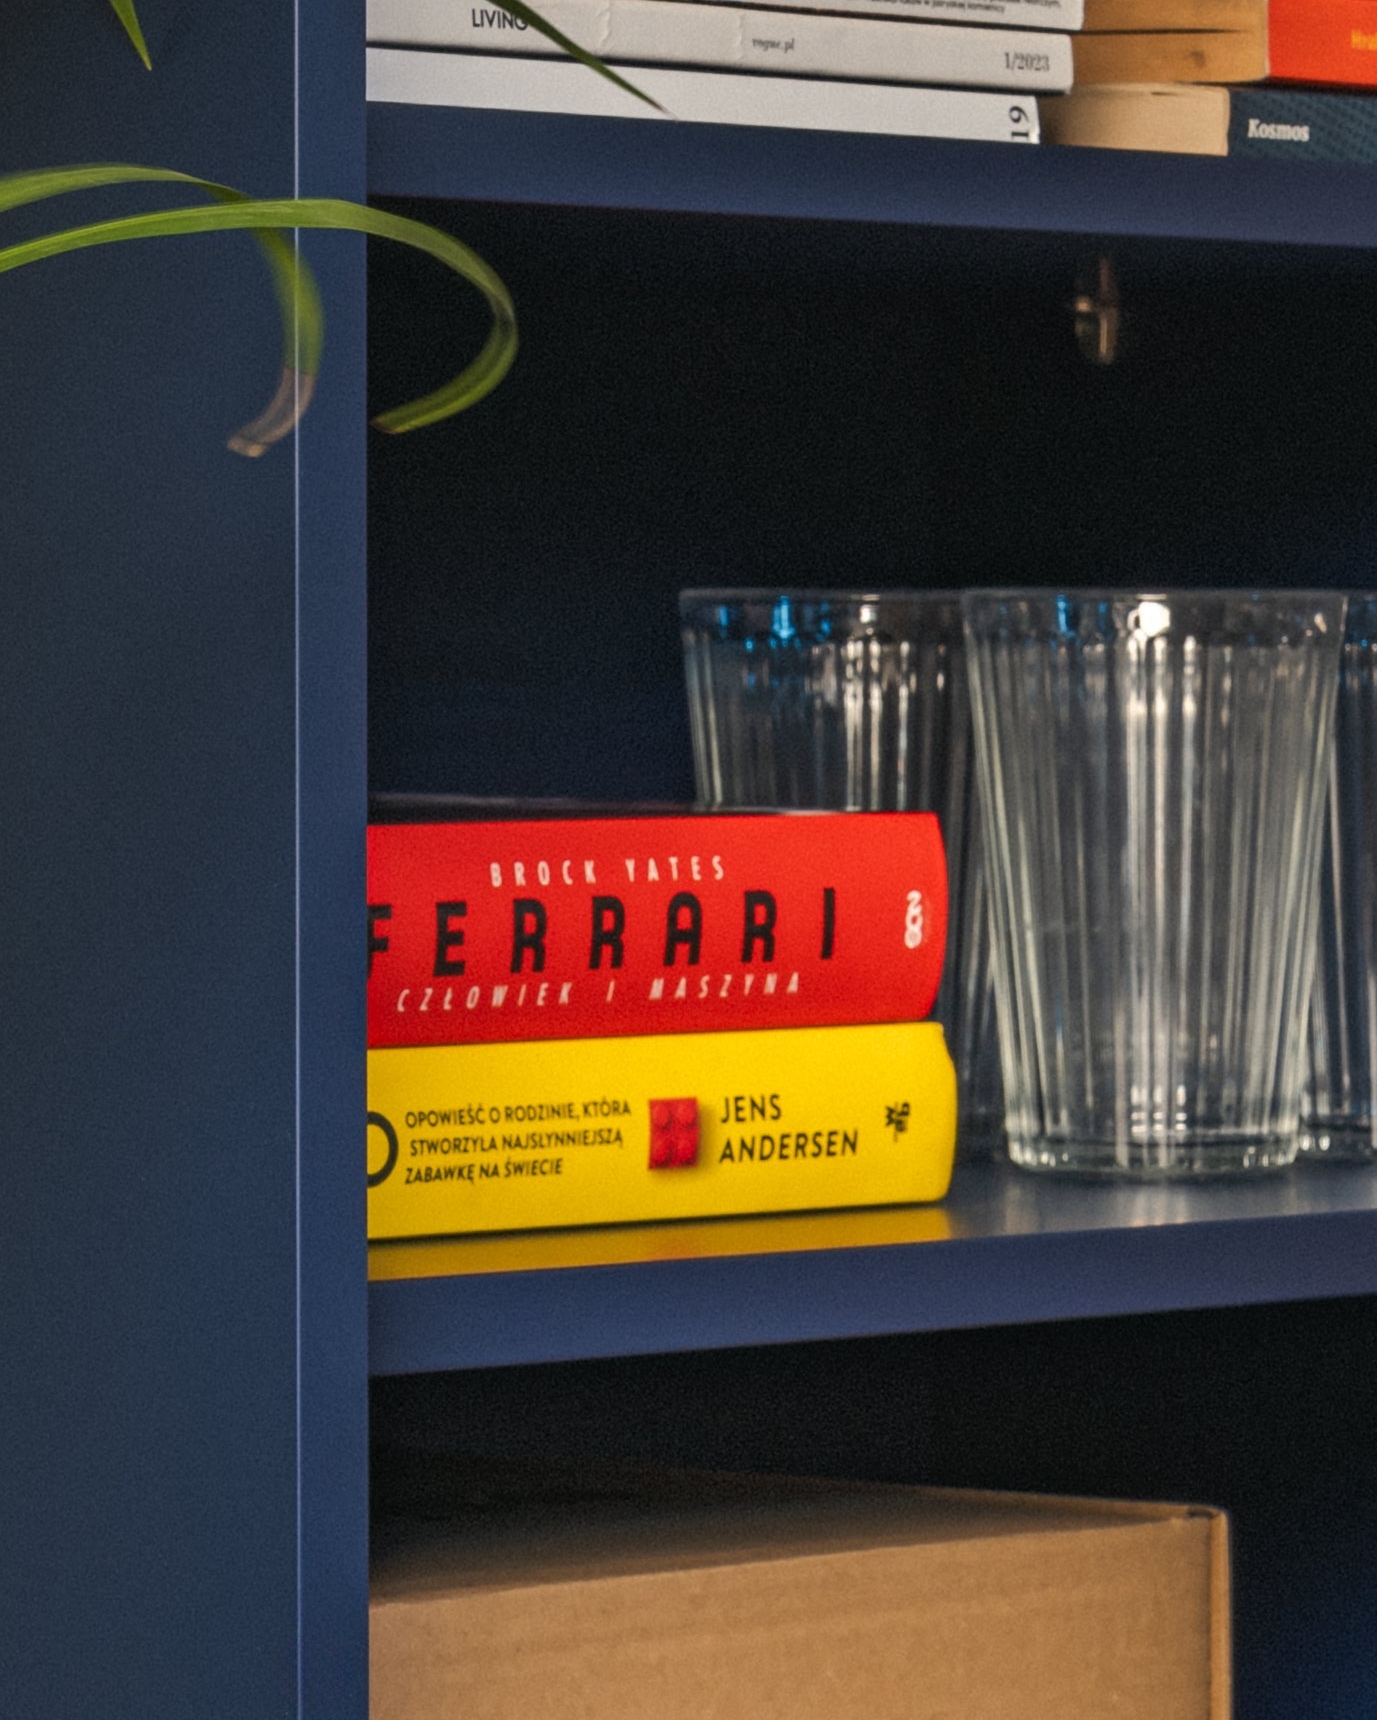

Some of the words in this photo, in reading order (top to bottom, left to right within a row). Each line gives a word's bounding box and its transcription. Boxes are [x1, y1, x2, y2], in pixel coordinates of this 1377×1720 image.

[1004, 51, 1050, 72] 1/2023
[1247, 118, 1310, 142] Kosmos
[490, 859, 597, 888] BROCK
[625, 855, 725, 882] YATES
[367, 886, 836, 980] FERRARI
[397, 982, 573, 1013] CZŁOWIEK
[606, 980, 616, 1004] I
[648, 971, 800, 1001] MASZYNA
[405, 1104, 485, 1128] OPOWIEŚĆ
[489, 1107, 501, 1124] O
[504, 1102, 581, 1122] RODZINIE,
[582, 1095, 632, 1118] KTÓRA
[721, 1094, 782, 1123] JENS
[719, 1130, 859, 1164] ANDERSEN
[405, 1164, 475, 1186] ZABAWKĘ
[479, 1161, 500, 1179] NA
[504, 1156, 563, 1179] ŚWIECIE
